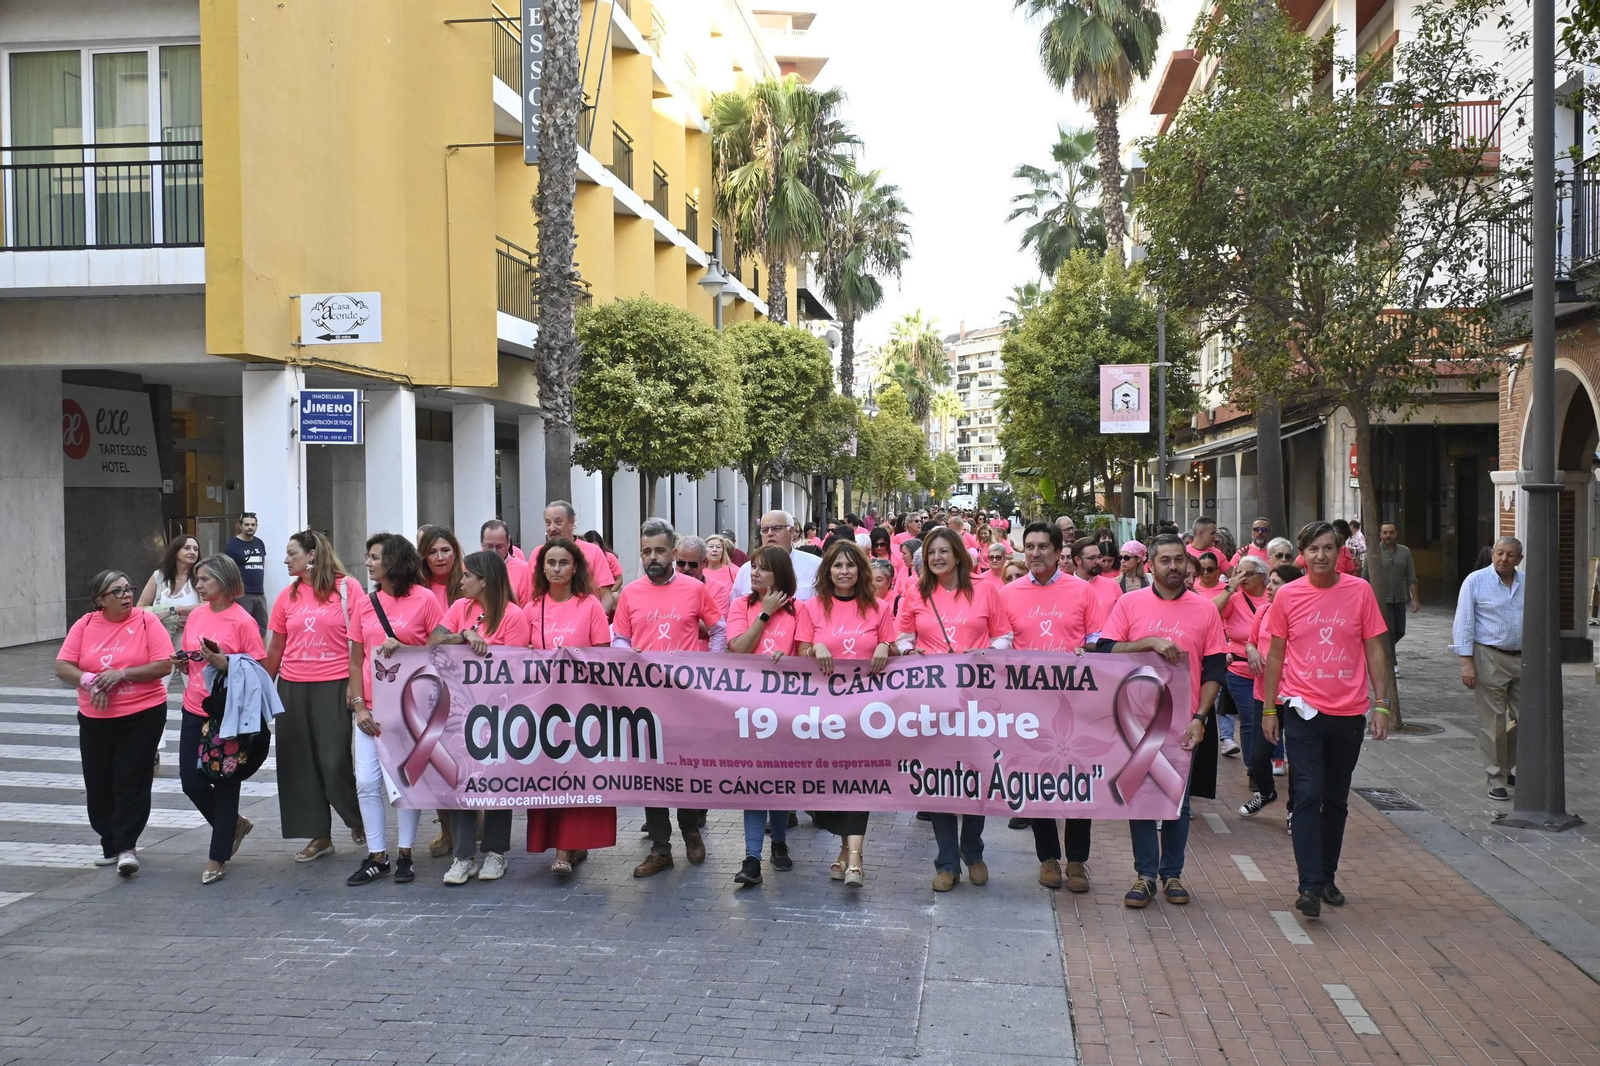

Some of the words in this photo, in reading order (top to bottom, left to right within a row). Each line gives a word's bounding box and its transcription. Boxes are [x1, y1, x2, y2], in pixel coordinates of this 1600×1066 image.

[302, 399, 352, 414] JIMENO
[96, 408, 130, 436] exe
[98, 444, 147, 456] TARTESSOS
[102, 461, 130, 473] HOTEL
[647, 607, 682, 621] Unidos
[1029, 604, 1064, 618] Unidos
[1307, 610, 1346, 626] Unidos
[831, 624, 866, 638] Unidos
[1148, 620, 1185, 637] Unidos
[1322, 648, 1347, 663] Vida
[462, 653, 514, 684] DÍA
[522, 660, 752, 692] INTERNACIONAL
[760, 670, 819, 696] DEL
[828, 665, 946, 696] CÁNCER
[956, 664, 996, 689] DE
[1005, 665, 1098, 691] MAMA
[734, 707, 778, 739] 19
[792, 706, 846, 740] de
[860, 700, 1040, 740] Octubre
[464, 703, 663, 764] aocam
[679, 755, 699, 769] hay
[702, 758, 717, 767] un
[718, 758, 753, 768] nuevo
[756, 759, 813, 769] amanecer
[815, 758, 829, 768] de
[832, 759, 892, 770] esperanza
[465, 771, 585, 793] ASOCIACIÓN
[592, 775, 683, 792] ONUBENSE
[690, 779, 712, 794] DE
[719, 776, 796, 794] CÁNCER
[802, 780, 825, 794] DE
[832, 779, 892, 794] MAMA
[465, 793, 602, 806] www.aocamhuelva.es
